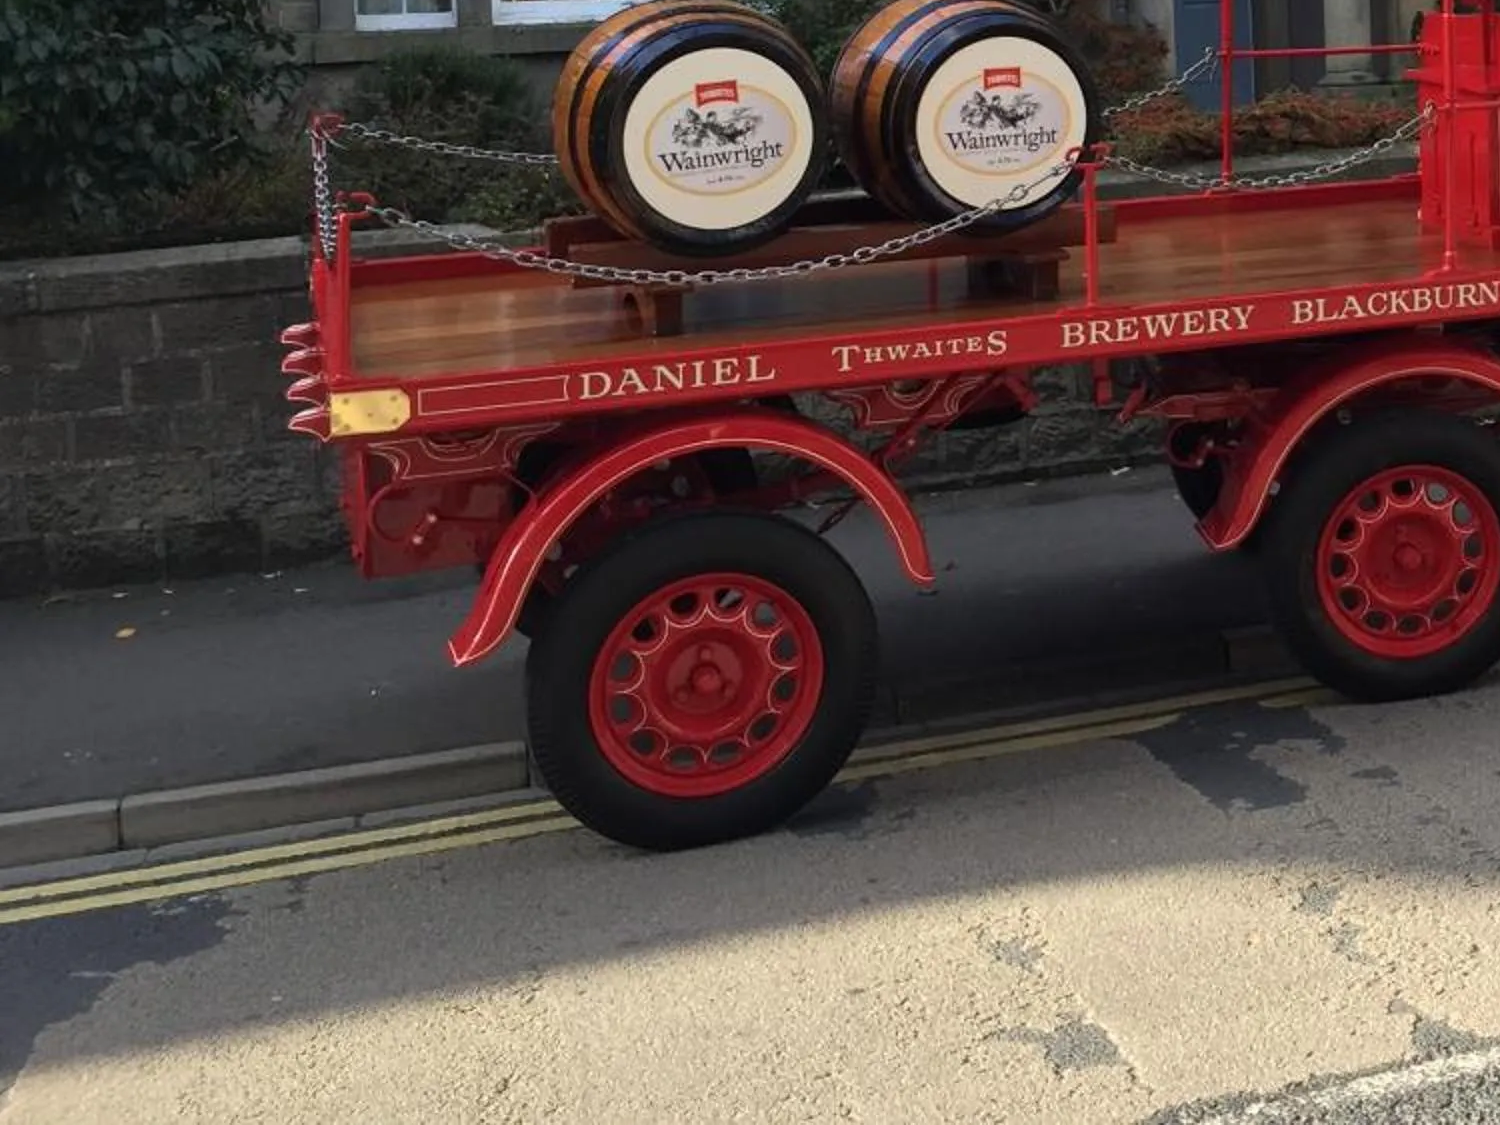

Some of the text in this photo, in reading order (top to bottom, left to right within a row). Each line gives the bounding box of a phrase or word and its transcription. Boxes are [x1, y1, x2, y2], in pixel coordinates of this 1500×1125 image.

[944, 126, 1058, 152] Wainwright
[658, 140, 784, 172] Wainwright
[578, 281, 1500, 400] DANIEL THWAITES BREWERY BLACKBURN
